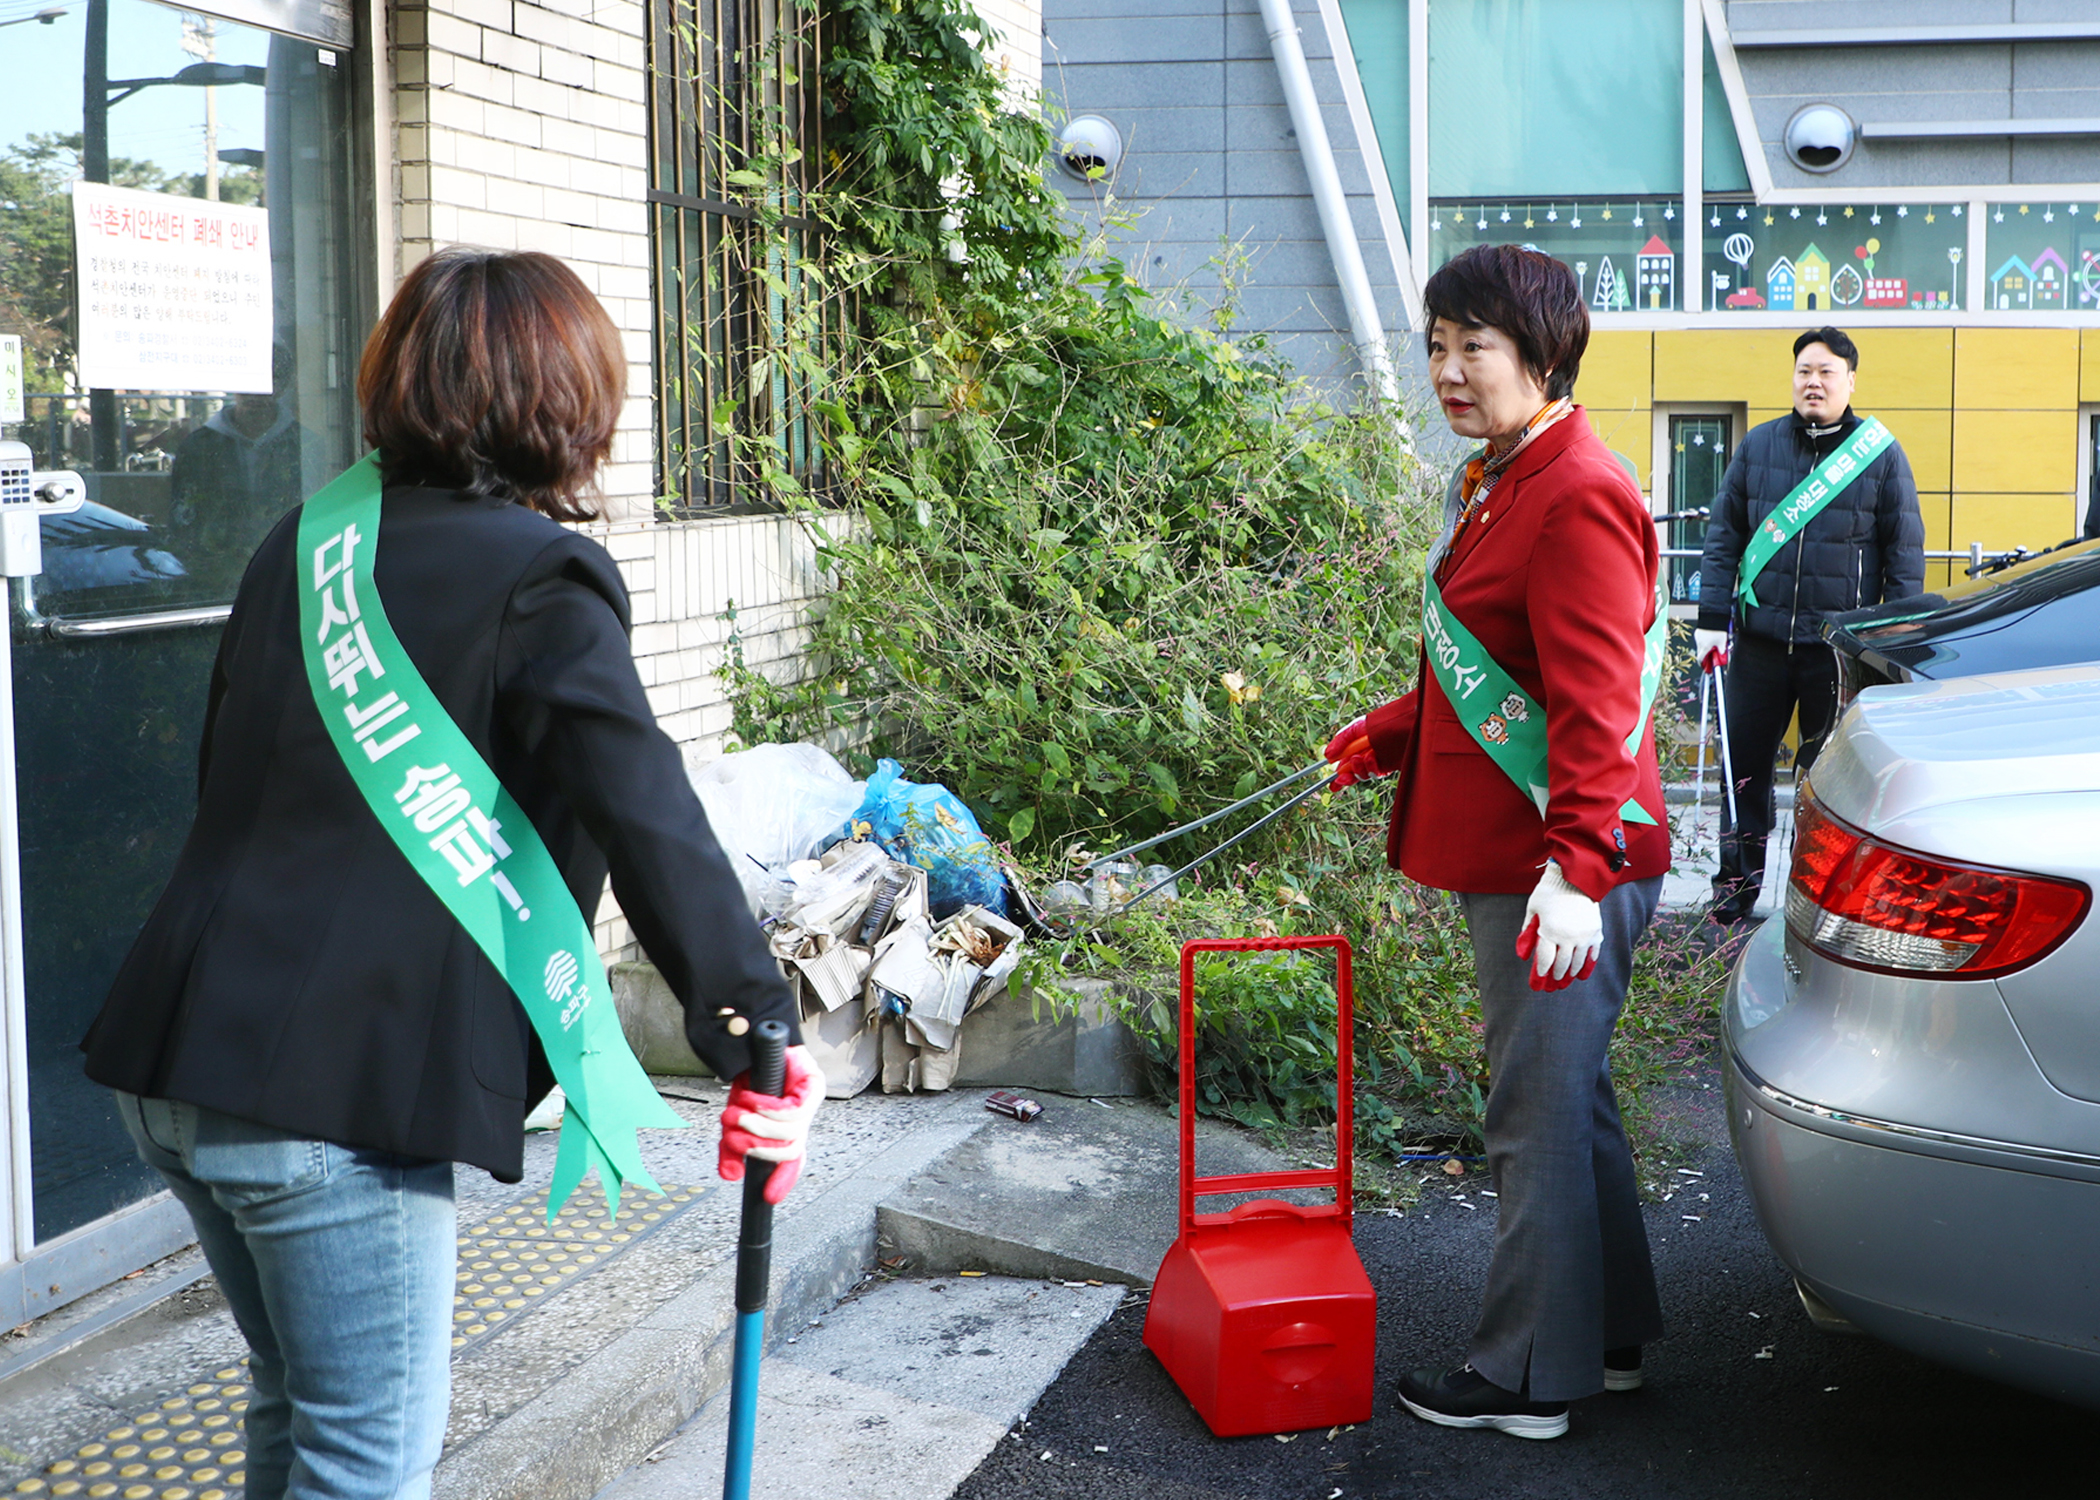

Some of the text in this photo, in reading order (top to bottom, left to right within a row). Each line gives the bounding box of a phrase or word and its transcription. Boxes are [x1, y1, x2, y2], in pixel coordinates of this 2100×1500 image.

[88, 203, 258, 251] 석촌치안센터 폐쇄 안내
[90, 256, 126, 274] 경찰청의
[131, 260, 149, 276] 전국
[154, 262, 188, 279] 치안센터
[214, 269, 239, 284] 방침에
[91, 278, 156, 299] 석촌치안센터가
[163, 285, 198, 303] 운영중단
[91, 301, 127, 319] 여러분의
[133, 304, 151, 320] 많은
[4, 341, 18, 400] 미시오
[1824, 453, 1857, 486] 마을
[1783, 480, 1829, 524] 대청소
[1424, 600, 1487, 700] 대청소
[394, 763, 530, 921] 송파!
[560, 984, 589, 1024] 송파구
